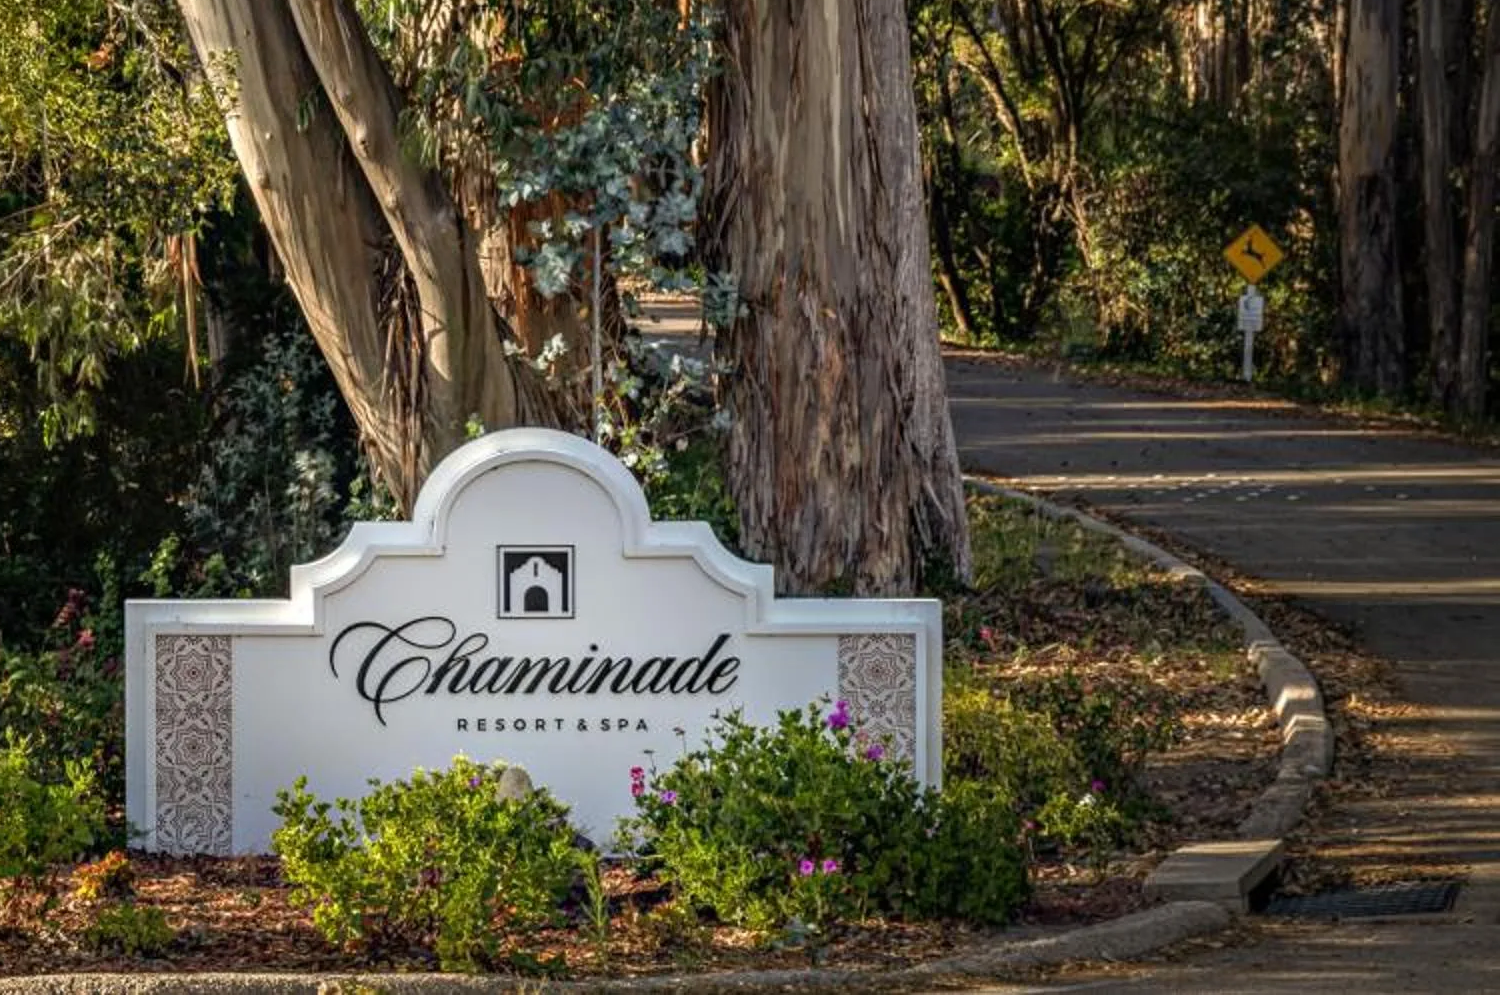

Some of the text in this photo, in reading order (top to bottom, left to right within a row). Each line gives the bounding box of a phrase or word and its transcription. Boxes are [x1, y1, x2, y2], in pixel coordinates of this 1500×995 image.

[329, 616, 741, 726] Chaminade
[457, 718, 649, 732] RESORT & SPA
